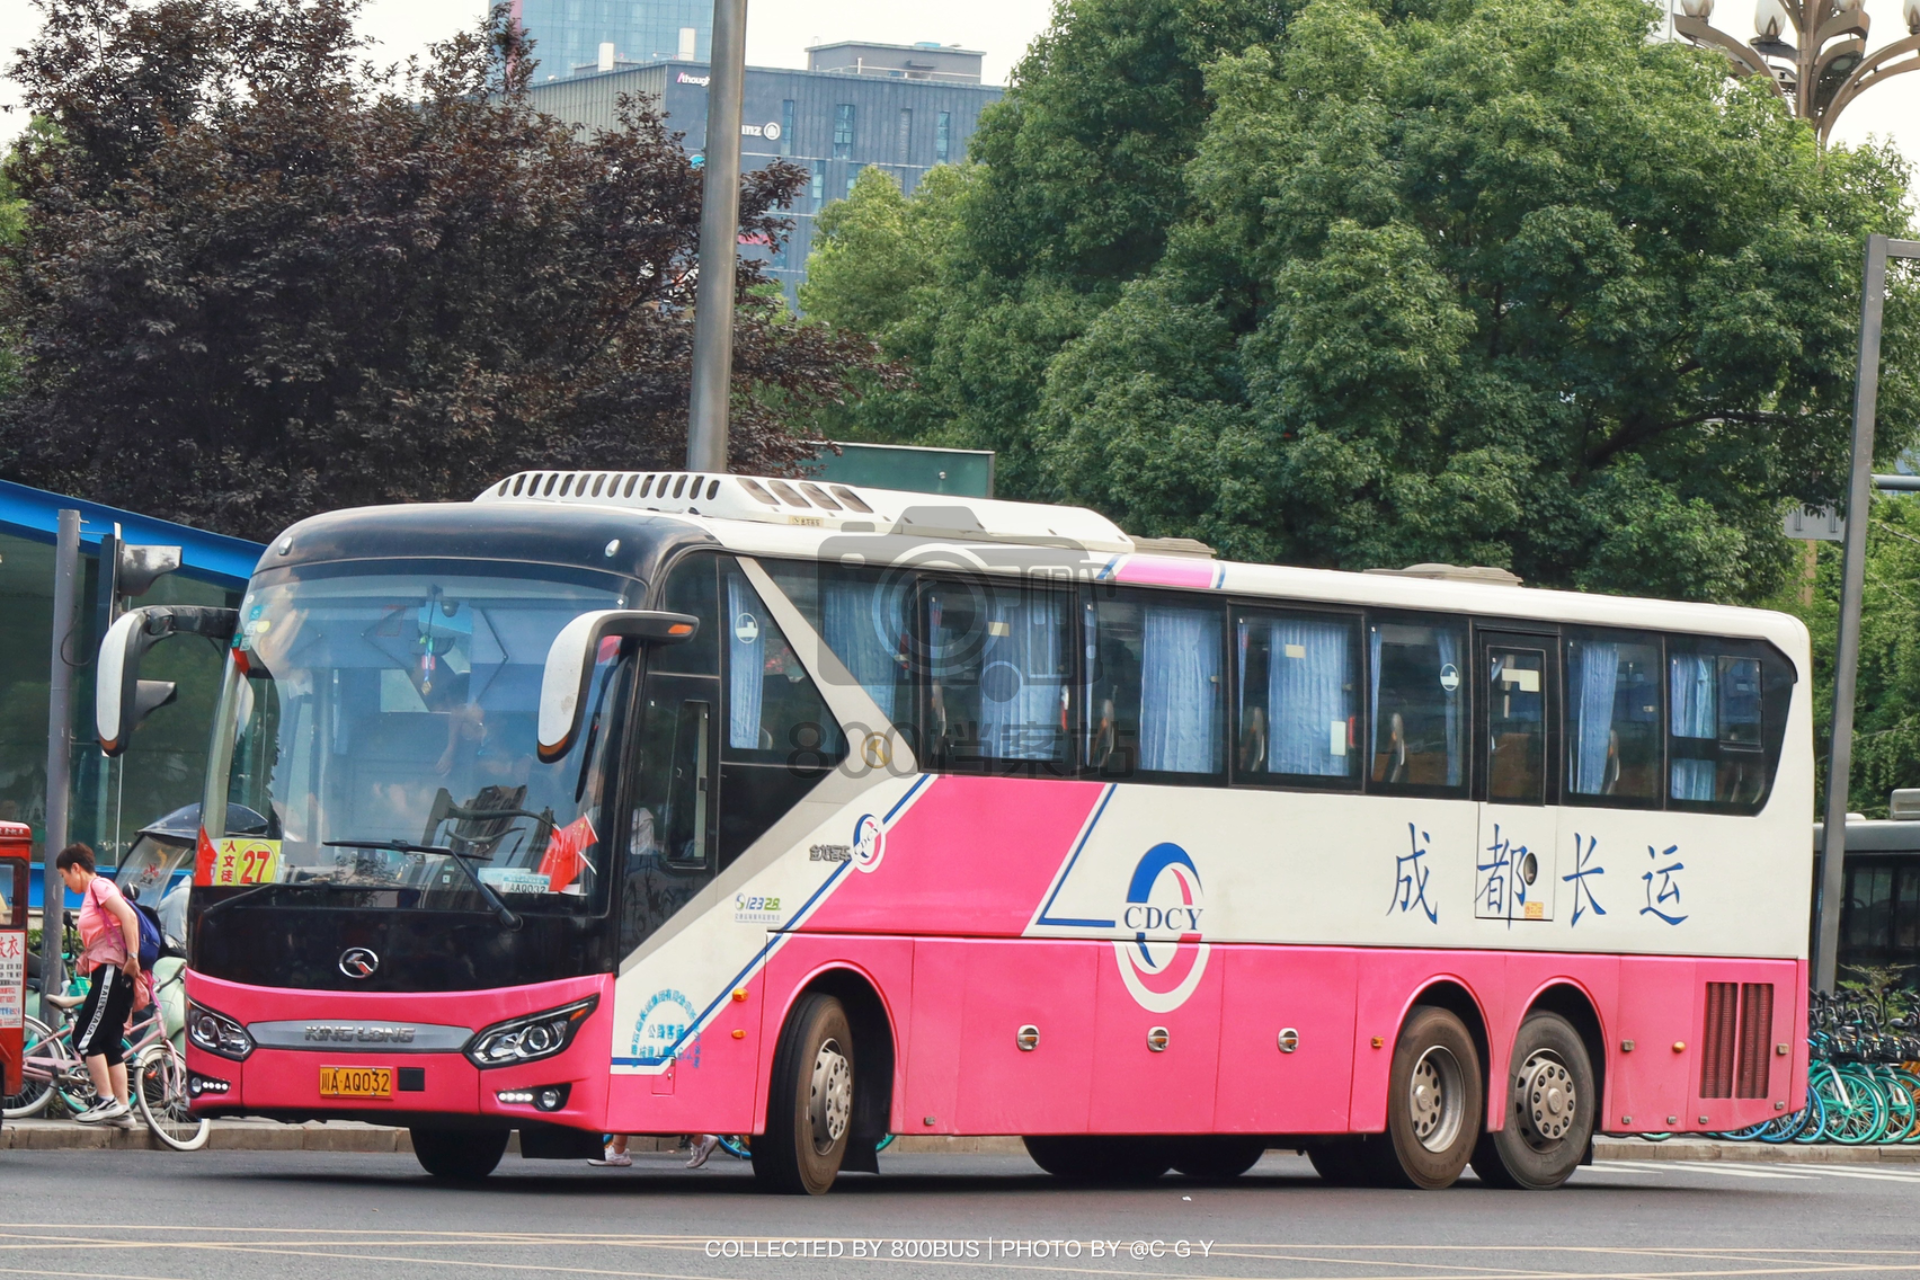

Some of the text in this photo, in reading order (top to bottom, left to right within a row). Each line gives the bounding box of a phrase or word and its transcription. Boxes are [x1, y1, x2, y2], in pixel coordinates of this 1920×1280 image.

[240, 850, 270, 884] 27
[1386, 822, 1689, 931] 成都长运
[1123, 905, 1204, 931] CDCY
[304, 1025, 417, 1043] KING LONG
